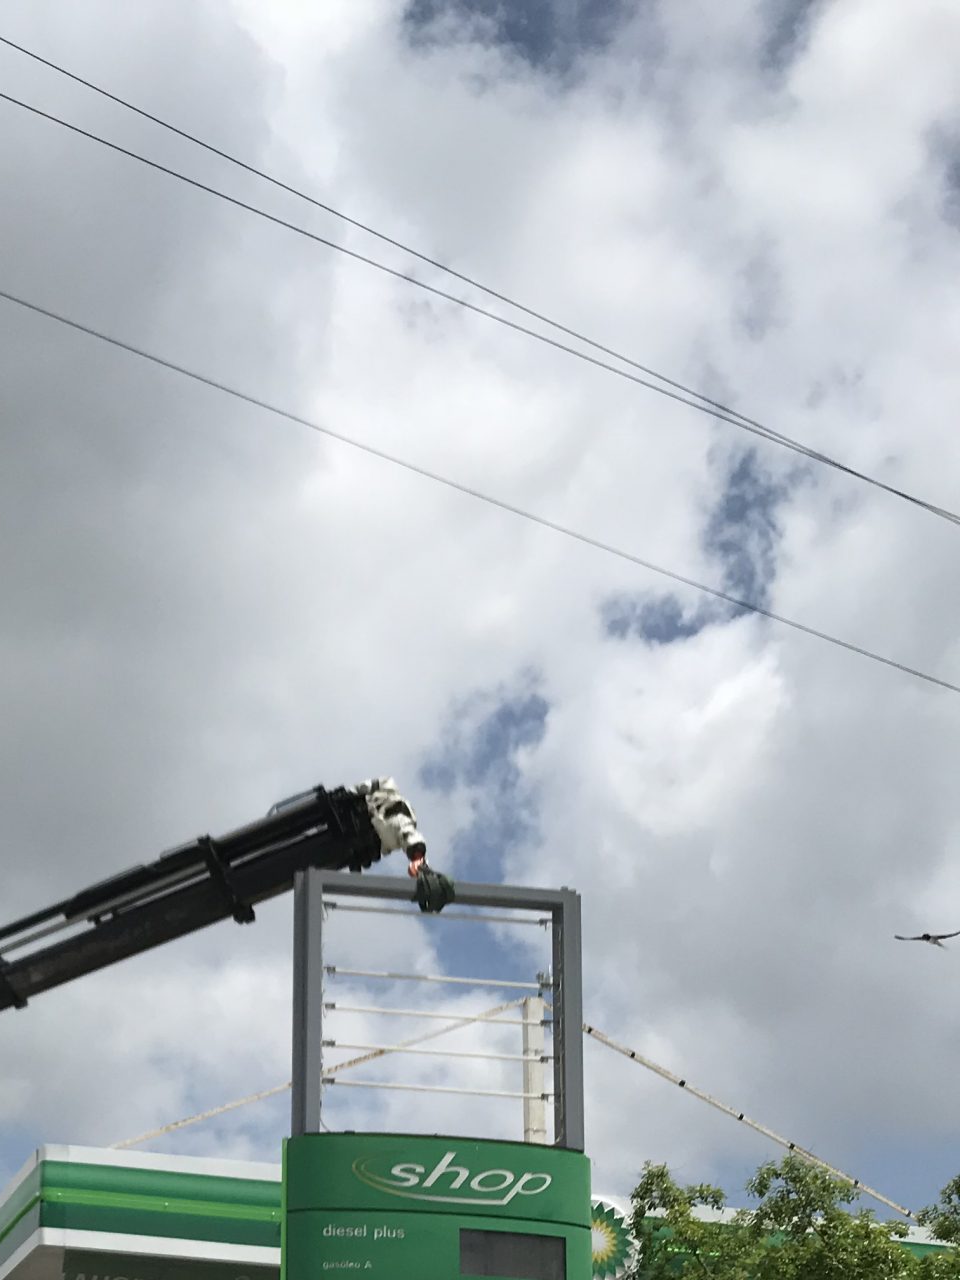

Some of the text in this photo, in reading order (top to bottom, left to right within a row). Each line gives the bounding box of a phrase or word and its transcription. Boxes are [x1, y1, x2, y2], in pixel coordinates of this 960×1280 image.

[390, 1151, 552, 1205] shop
[323, 1224, 405, 1240] diesel plus
[364, 1261, 372, 1269] A
